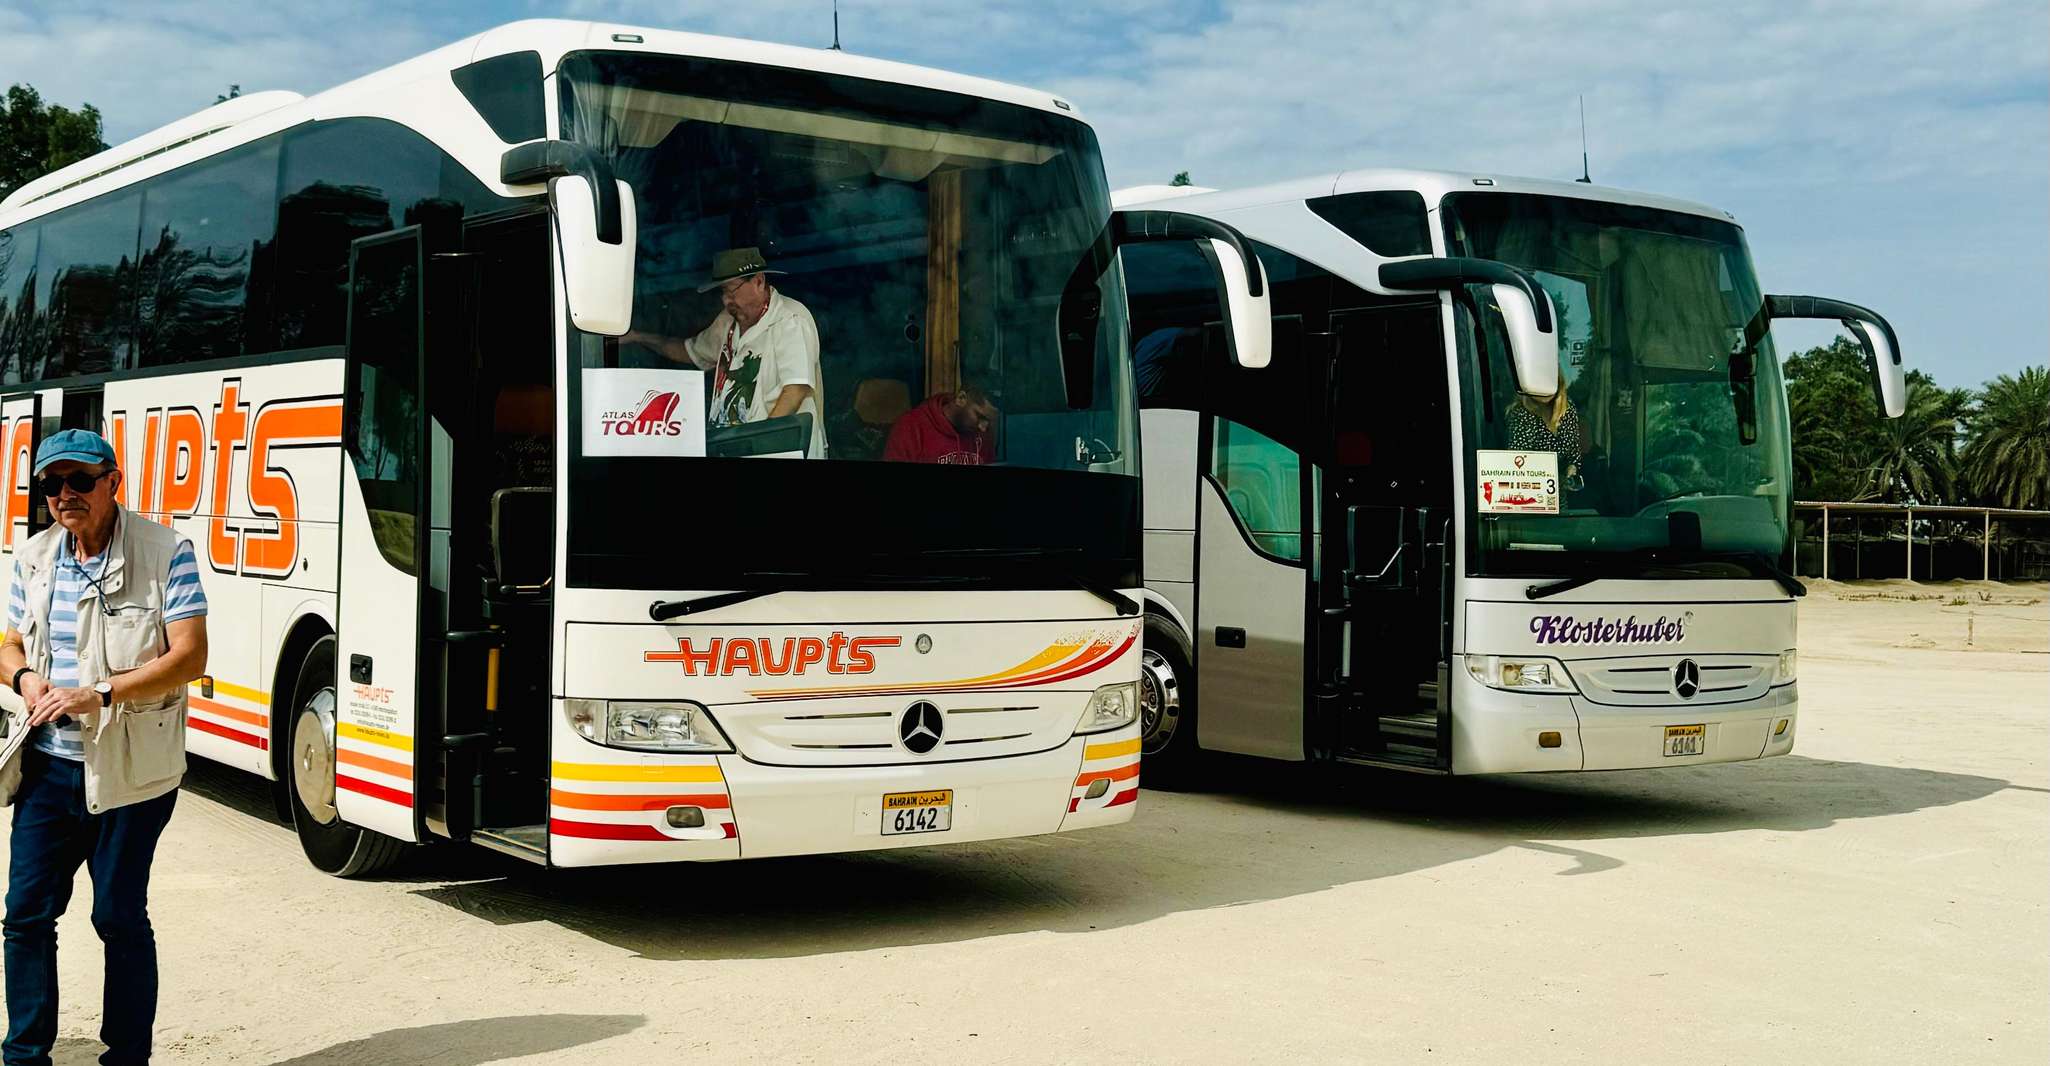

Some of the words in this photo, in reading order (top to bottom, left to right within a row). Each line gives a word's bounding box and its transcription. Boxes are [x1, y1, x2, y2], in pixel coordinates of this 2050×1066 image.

[601, 411, 635, 419] ATLAS
[601, 420, 682, 436] TOURS
[1546, 479, 1556, 495] 3
[1529, 615, 1685, 645] Klosterhuber
[1672, 737, 1696, 754] 6141
[888, 797, 918, 807] BAHRAIN
[894, 808, 938, 831] 6142
